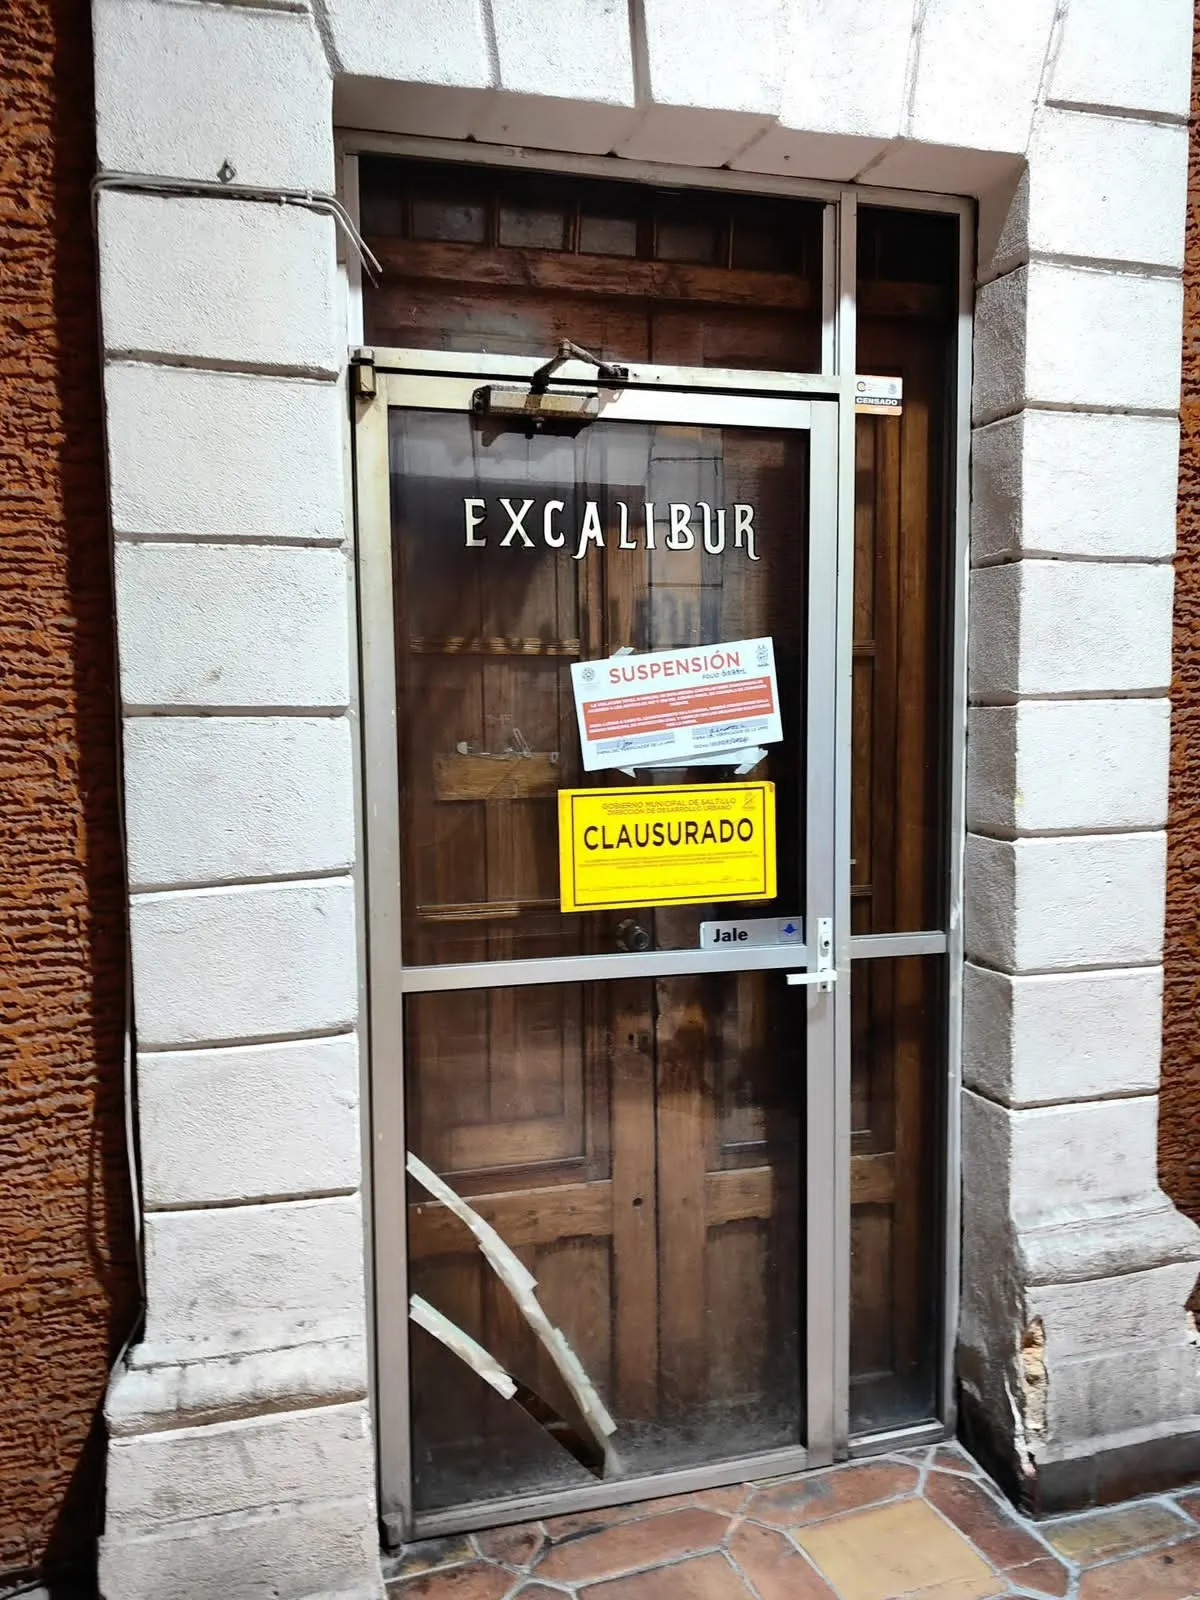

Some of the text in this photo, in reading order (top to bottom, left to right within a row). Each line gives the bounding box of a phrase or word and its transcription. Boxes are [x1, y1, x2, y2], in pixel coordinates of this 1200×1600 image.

[856, 397, 898, 406] CENSADO
[462, 497, 761, 561] EXCALIBUR
[609, 650, 741, 684] SUSPENSIÓN
[602, 801, 644, 810] GOBIERNO
[645, 799, 687, 808] MUNICIPAL
[701, 797, 737, 805] SALTILLO
[583, 817, 754, 850] CLAUSURADO
[713, 928, 749, 943] Jale
